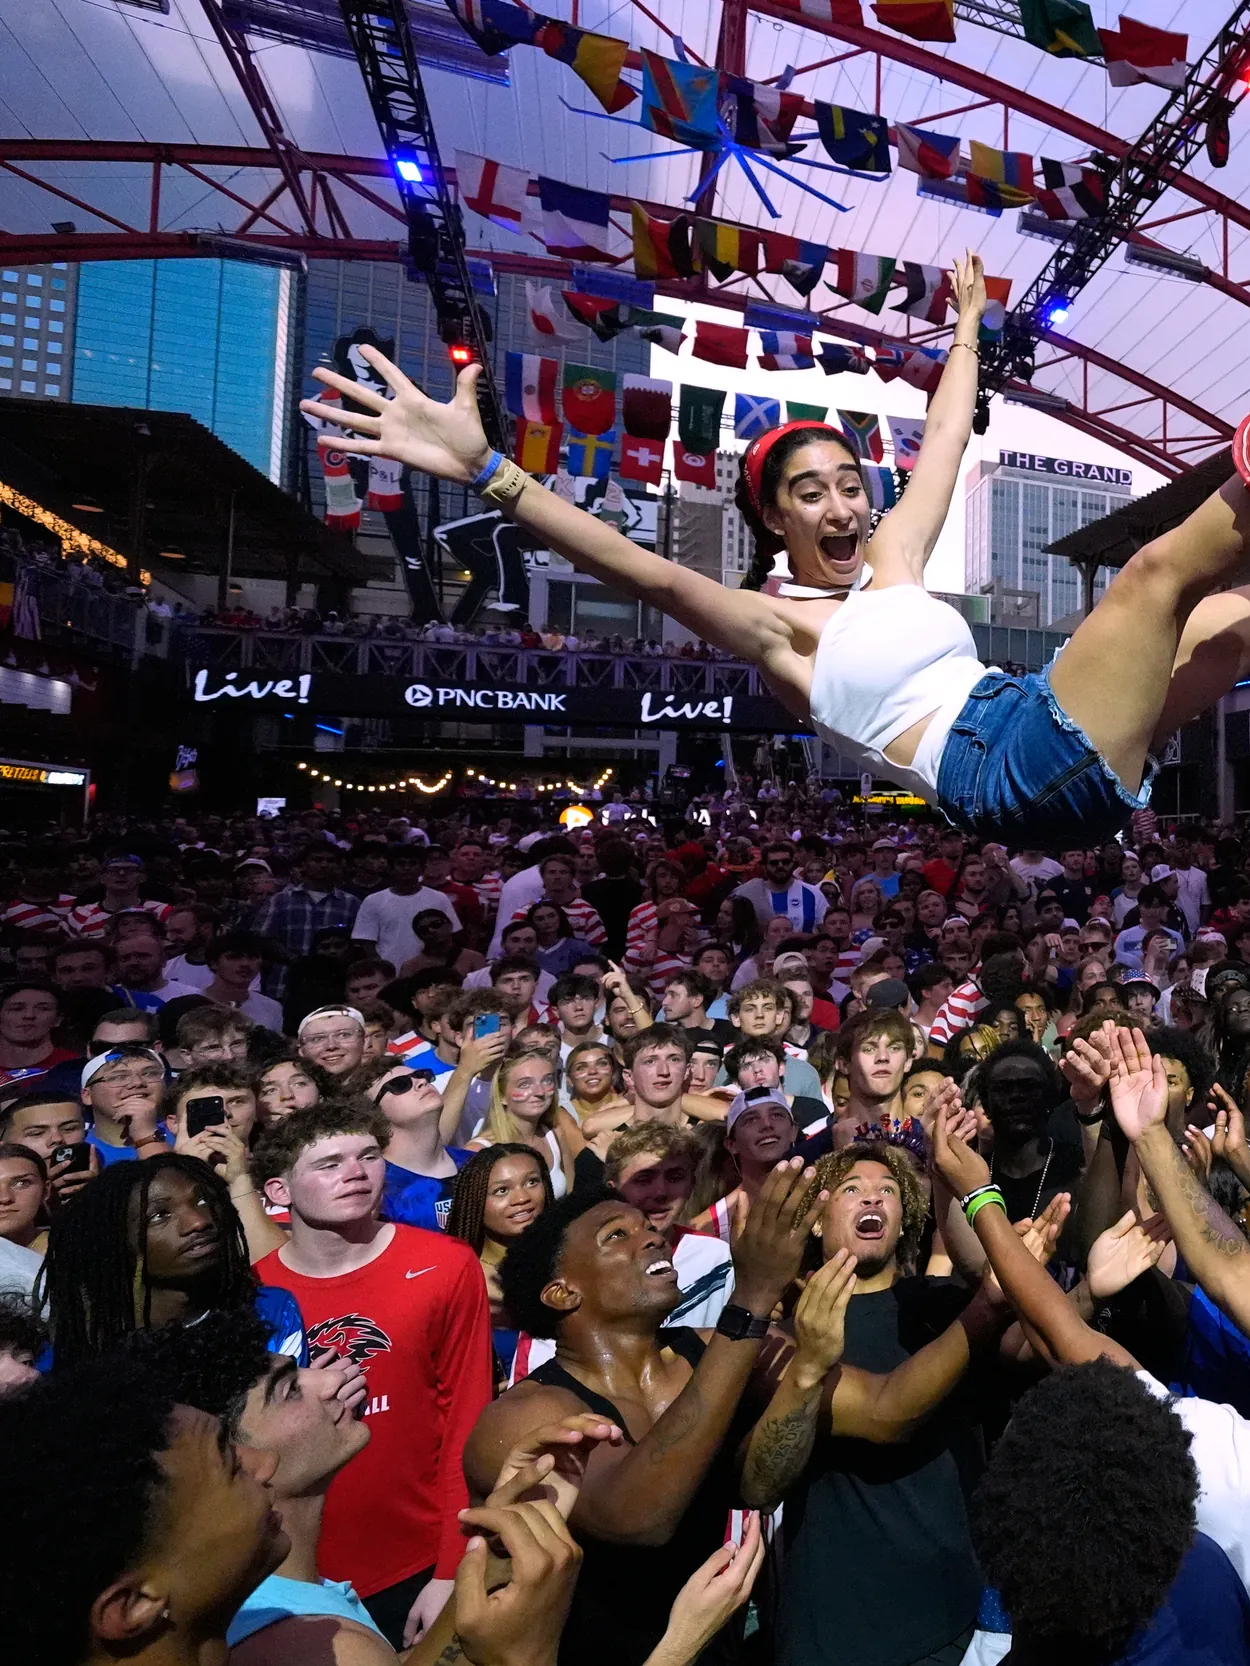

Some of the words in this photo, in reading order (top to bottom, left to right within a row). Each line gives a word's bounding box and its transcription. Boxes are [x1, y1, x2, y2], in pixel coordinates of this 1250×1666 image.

[1001, 451, 1047, 471] THE
[1054, 459, 1133, 485] GRAND
[194, 669, 312, 704] Live!
[640, 692, 733, 724] Live!
